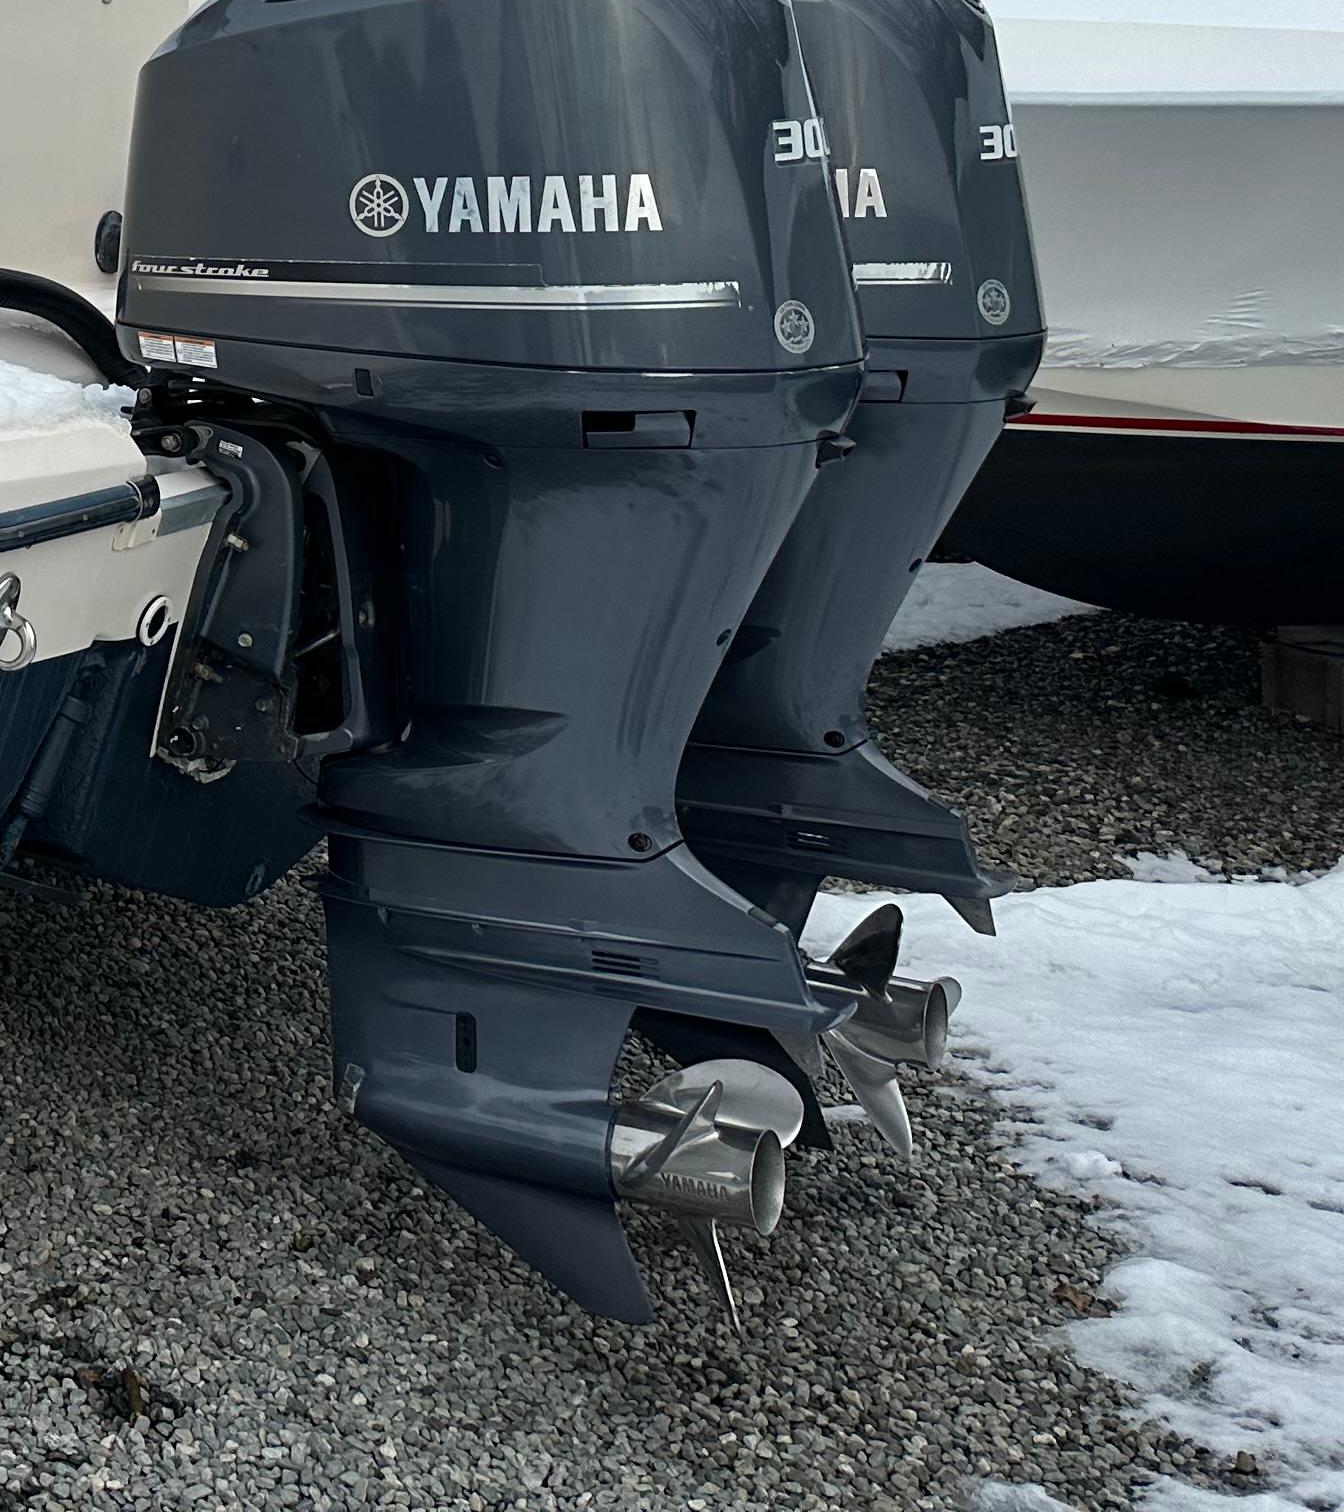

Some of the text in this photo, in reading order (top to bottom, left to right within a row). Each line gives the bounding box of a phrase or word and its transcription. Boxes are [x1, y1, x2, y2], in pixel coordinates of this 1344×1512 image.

[772, 118, 831, 162] 30
[413, 174, 664, 233] YAMAHA
[658, 1172, 729, 1201] YAMAHA
